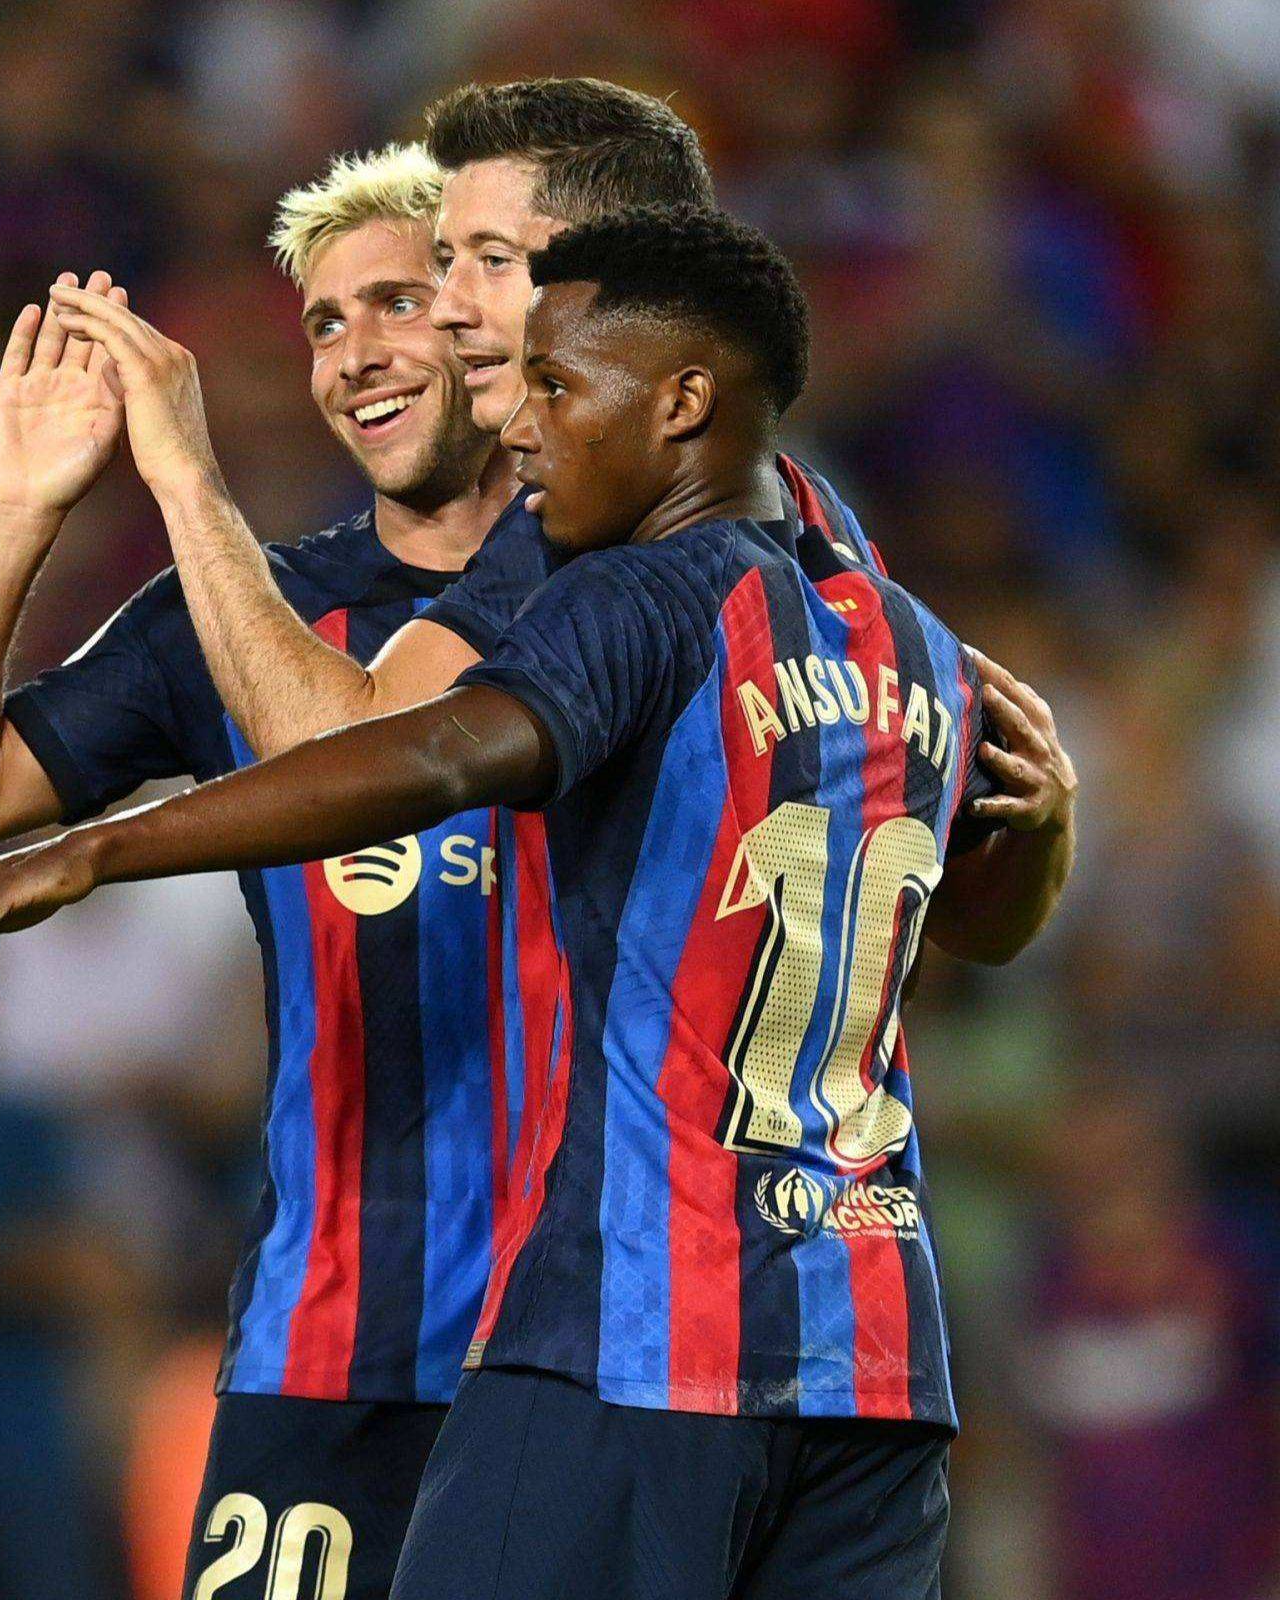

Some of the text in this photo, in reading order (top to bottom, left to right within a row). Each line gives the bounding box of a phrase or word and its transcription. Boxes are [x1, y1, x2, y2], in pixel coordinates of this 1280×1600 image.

[736, 654, 870, 758] ANSU
[715, 801, 943, 1168] 10
[822, 1201, 919, 1231] ACNUR
[836, 1179, 917, 1207] HCR
[193, 1492, 354, 1600] 20
